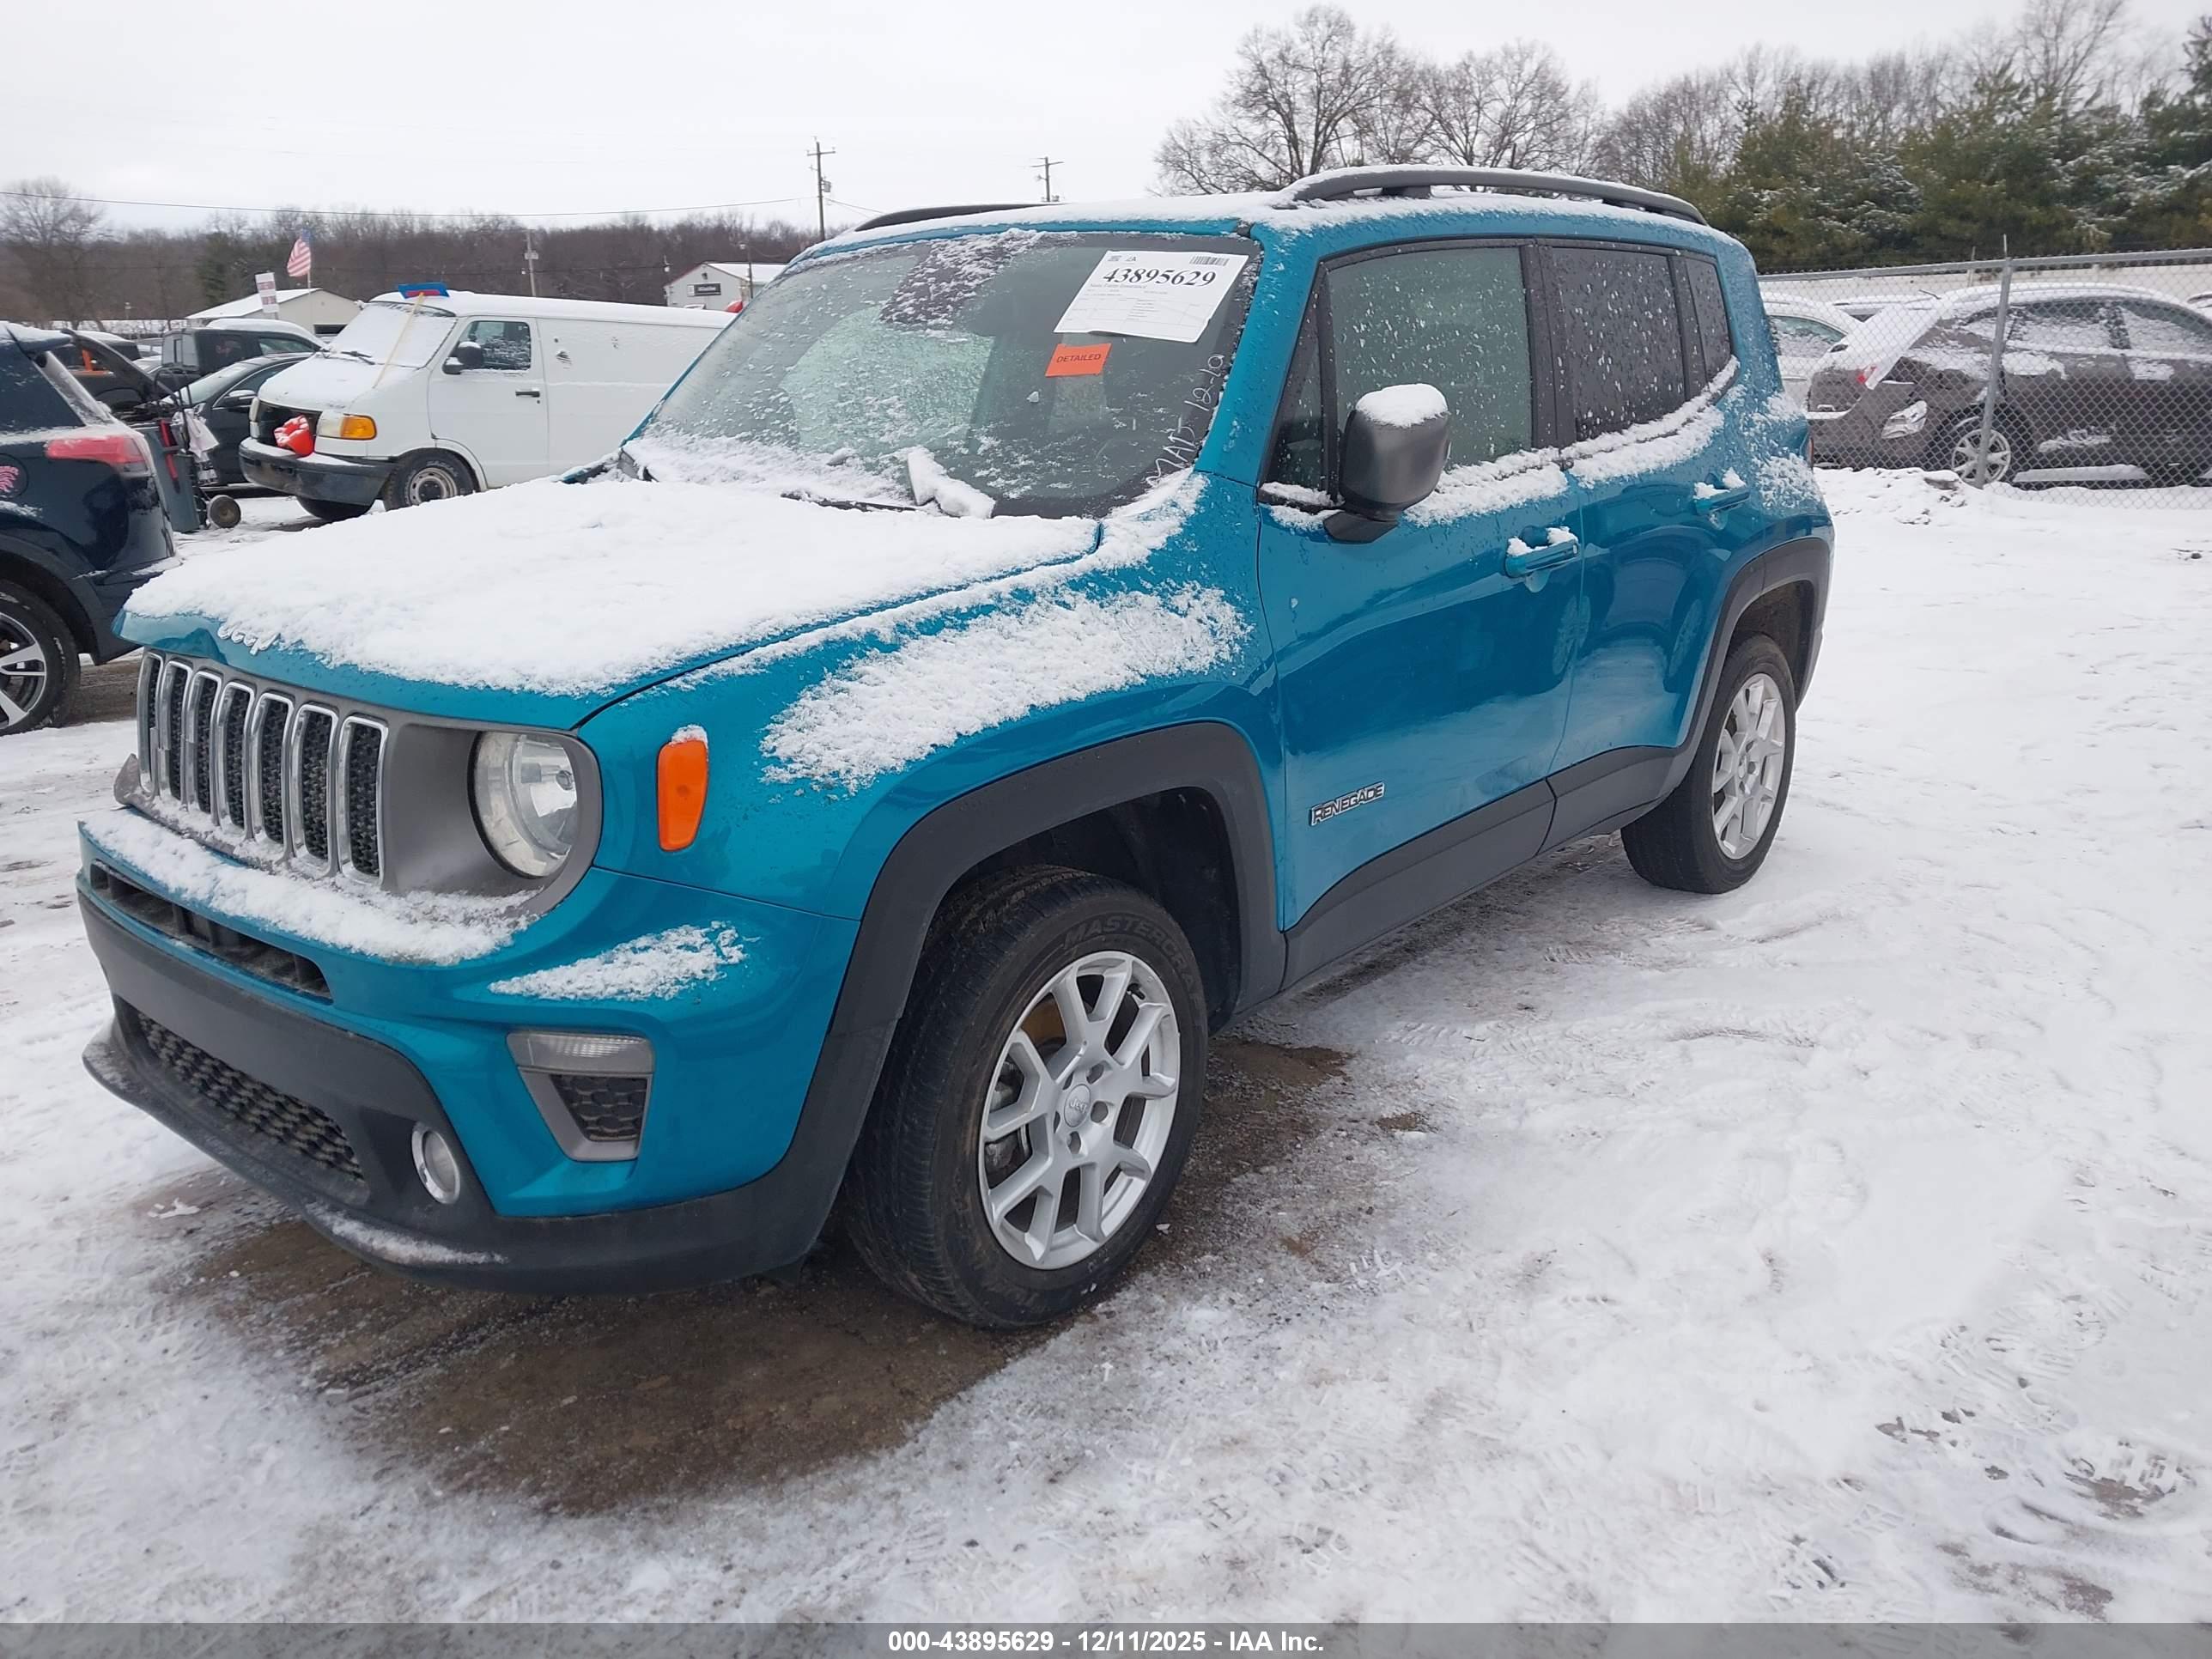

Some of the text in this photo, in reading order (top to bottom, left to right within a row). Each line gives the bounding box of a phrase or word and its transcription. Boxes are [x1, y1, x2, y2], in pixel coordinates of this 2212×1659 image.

[1103, 267, 1217, 288] 43895629
[1056, 353, 1102, 363] DETAILED
[1310, 781, 1385, 826] RENEGADE
